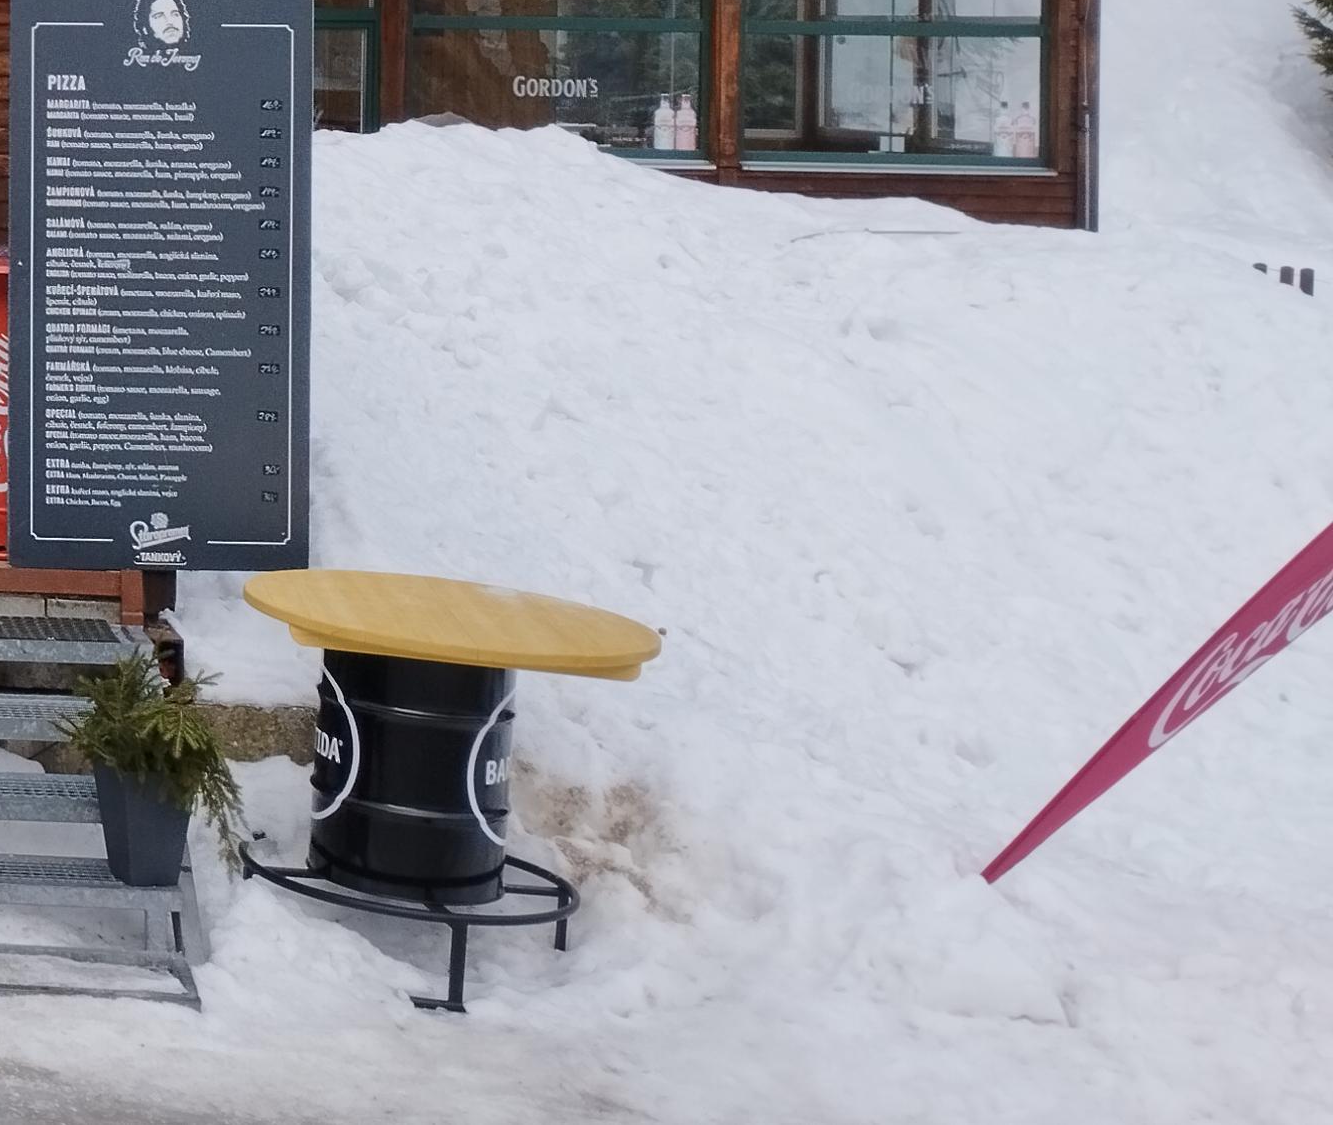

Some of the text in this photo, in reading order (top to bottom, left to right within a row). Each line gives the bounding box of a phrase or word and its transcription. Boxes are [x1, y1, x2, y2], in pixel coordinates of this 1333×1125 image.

[47, 74, 86, 91] PIZZA
[512, 75, 599, 98] GORDON'S
[46, 99, 91, 110] MARGARITA
[45, 458, 70, 469] EXTRA
[45, 484, 70, 495] EXTRA
